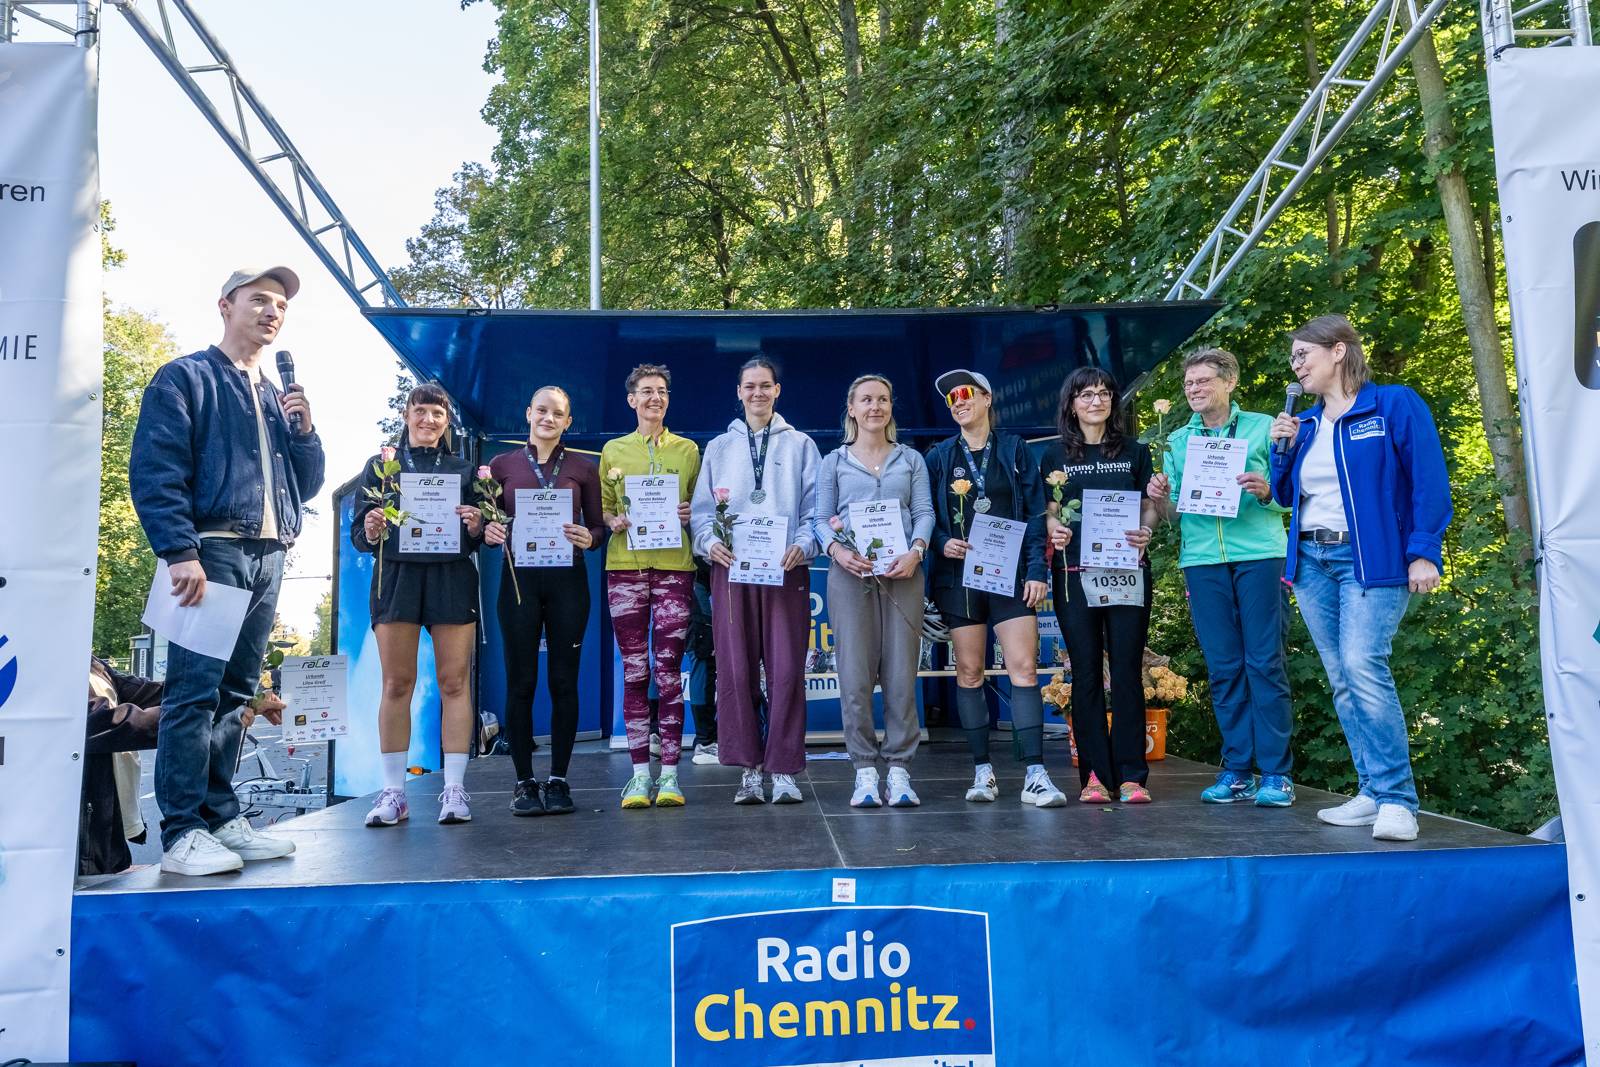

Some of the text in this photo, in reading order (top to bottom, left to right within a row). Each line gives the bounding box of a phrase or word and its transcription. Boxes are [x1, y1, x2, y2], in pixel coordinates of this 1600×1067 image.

[1560, 169, 1600, 191] Wi
[1063, 461, 1131, 473] bruno banani
[1092, 574, 1137, 588] 10330
[757, 930, 910, 982] Radio
